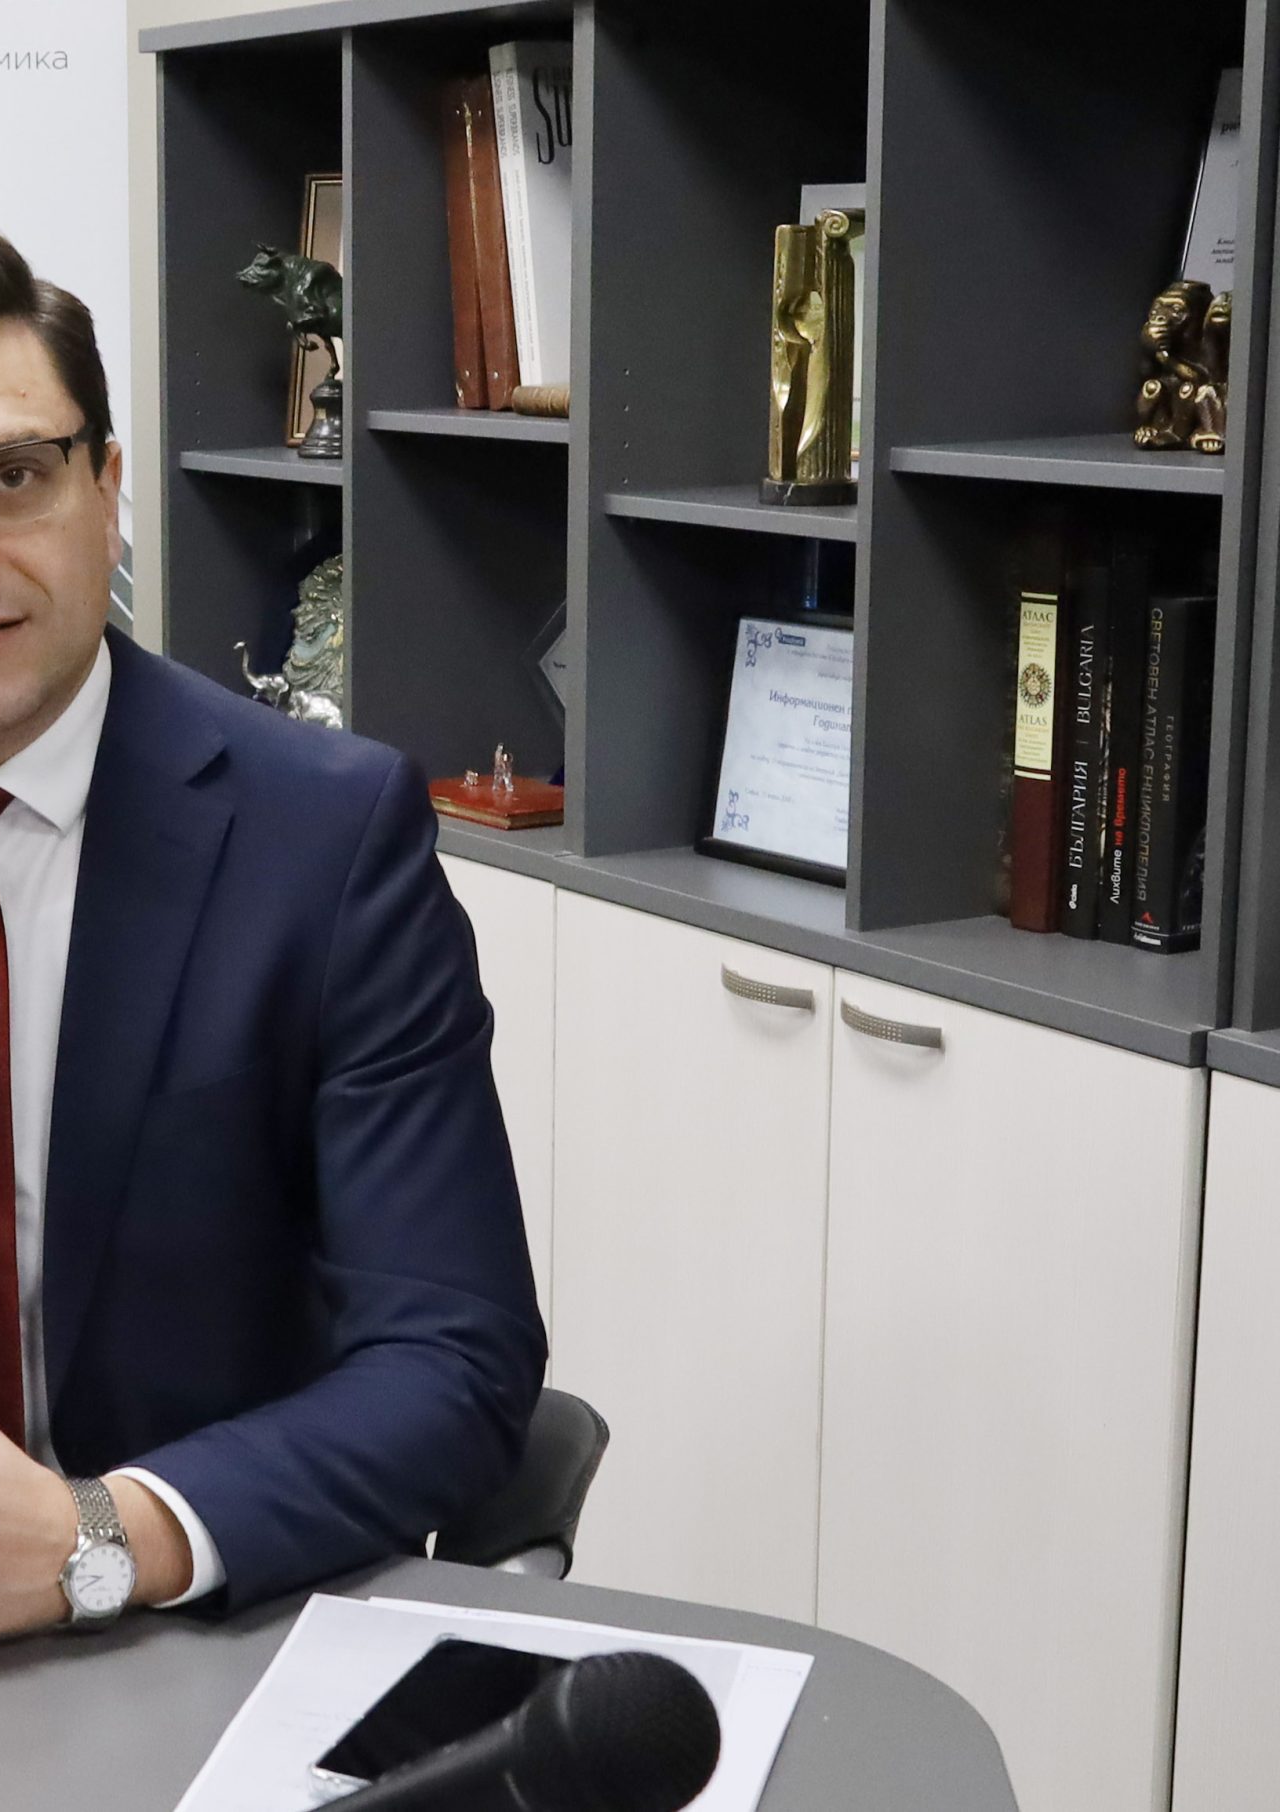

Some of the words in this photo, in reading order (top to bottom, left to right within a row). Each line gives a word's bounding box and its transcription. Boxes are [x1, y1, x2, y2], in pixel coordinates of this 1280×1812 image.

[1076, 624, 1094, 723] BULGARIA
[1147, 607, 1163, 700] СВЕТОВЕН
[769, 689, 845, 715] Информационен
[1019, 713, 1048, 726] ATLAS
[1142, 703, 1157, 760] АТЛАС
[1162, 715, 1174, 802] ГЕОГРАФИЯ
[1069, 761, 1088, 868] БЪЛГАРИЯ
[1115, 831, 1124, 846] на
[1136, 764, 1154, 901] ЕНЦИКЛОПЕДИЯ
